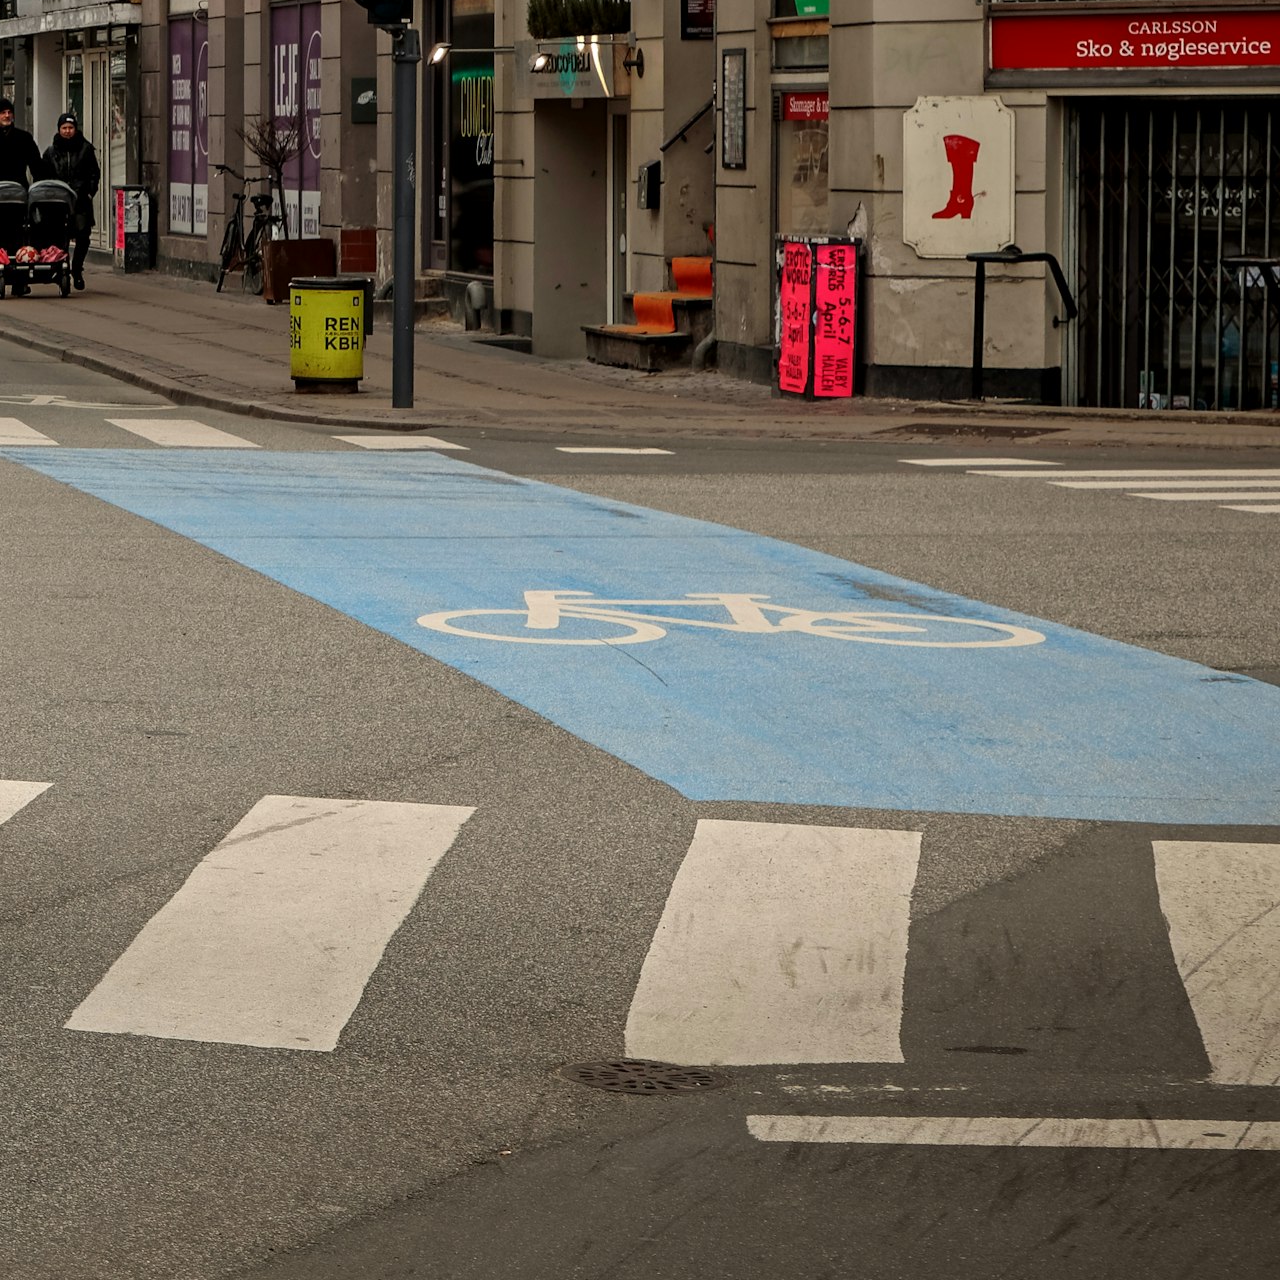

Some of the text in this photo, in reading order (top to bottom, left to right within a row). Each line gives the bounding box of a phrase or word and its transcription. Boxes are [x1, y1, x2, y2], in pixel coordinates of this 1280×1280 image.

[1128, 20, 1217, 35] CARLSSON
[1076, 37, 1271, 61] Sko & nøgleservice
[460, 75, 495, 138] COMED
[786, 248, 810, 269] EROTIC
[827, 249, 837, 292] WORLD
[836, 248, 846, 291] EROTIC
[786, 268, 809, 287] WORLD
[325, 316, 360, 331] REN
[823, 301, 837, 339] April
[838, 297, 851, 345] 5-6-7
[325, 336, 360, 350] KBH
[788, 324, 804, 348] April
[821, 354, 835, 392] HALLEN
[835, 357, 848, 389] VALBY
